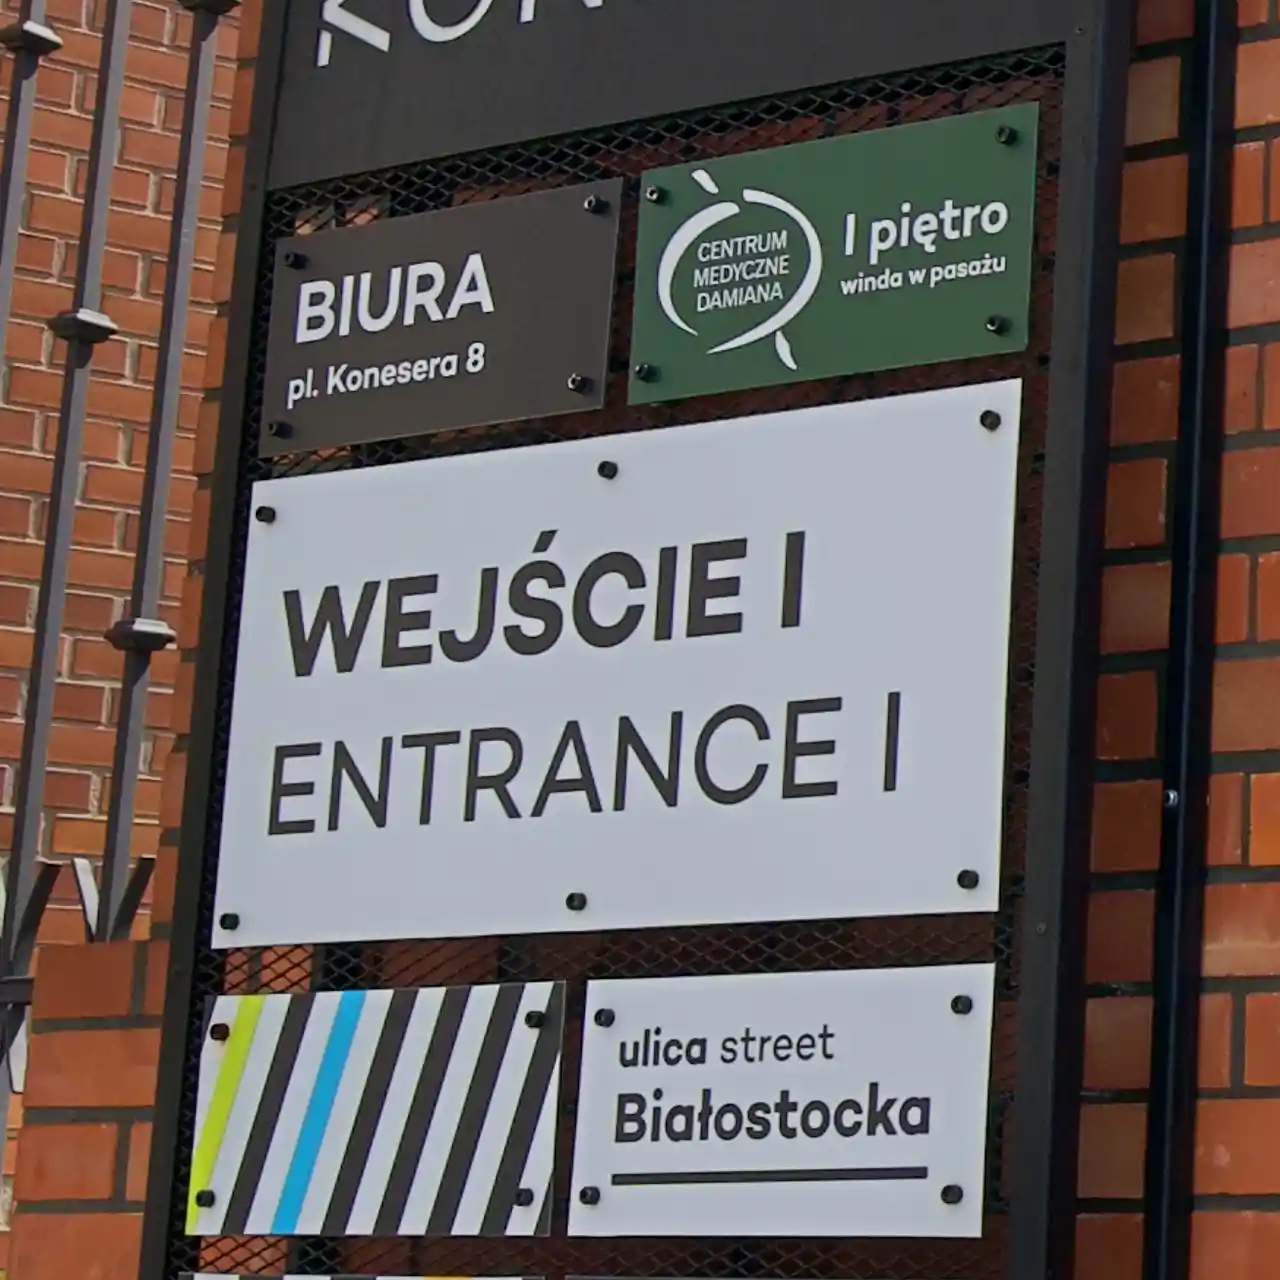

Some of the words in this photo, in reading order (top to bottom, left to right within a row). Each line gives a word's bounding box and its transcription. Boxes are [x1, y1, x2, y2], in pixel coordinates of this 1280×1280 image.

[697, 230, 788, 262] CENTRUM
[844, 213, 856, 256] I
[869, 199, 1010, 265] piętro
[295, 252, 495, 343] BIURA
[693, 254, 790, 288] MEDYCZNE
[696, 281, 784, 312] DAMIANA
[840, 268, 903, 295] winda
[908, 267, 929, 284] w
[930, 253, 1006, 287] pasażu
[286, 368, 319, 410] pl.
[326, 352, 458, 395] Konesera
[465, 341, 486, 373] 8
[282, 528, 748, 678] WEJŚCIE
[780, 530, 806, 629] I
[267, 696, 843, 836] ENTRANCE
[883, 691, 901, 792] I
[619, 1027, 707, 1068] ulica
[720, 1024, 835, 1064] street
[614, 1082, 931, 1143] Białostocka
